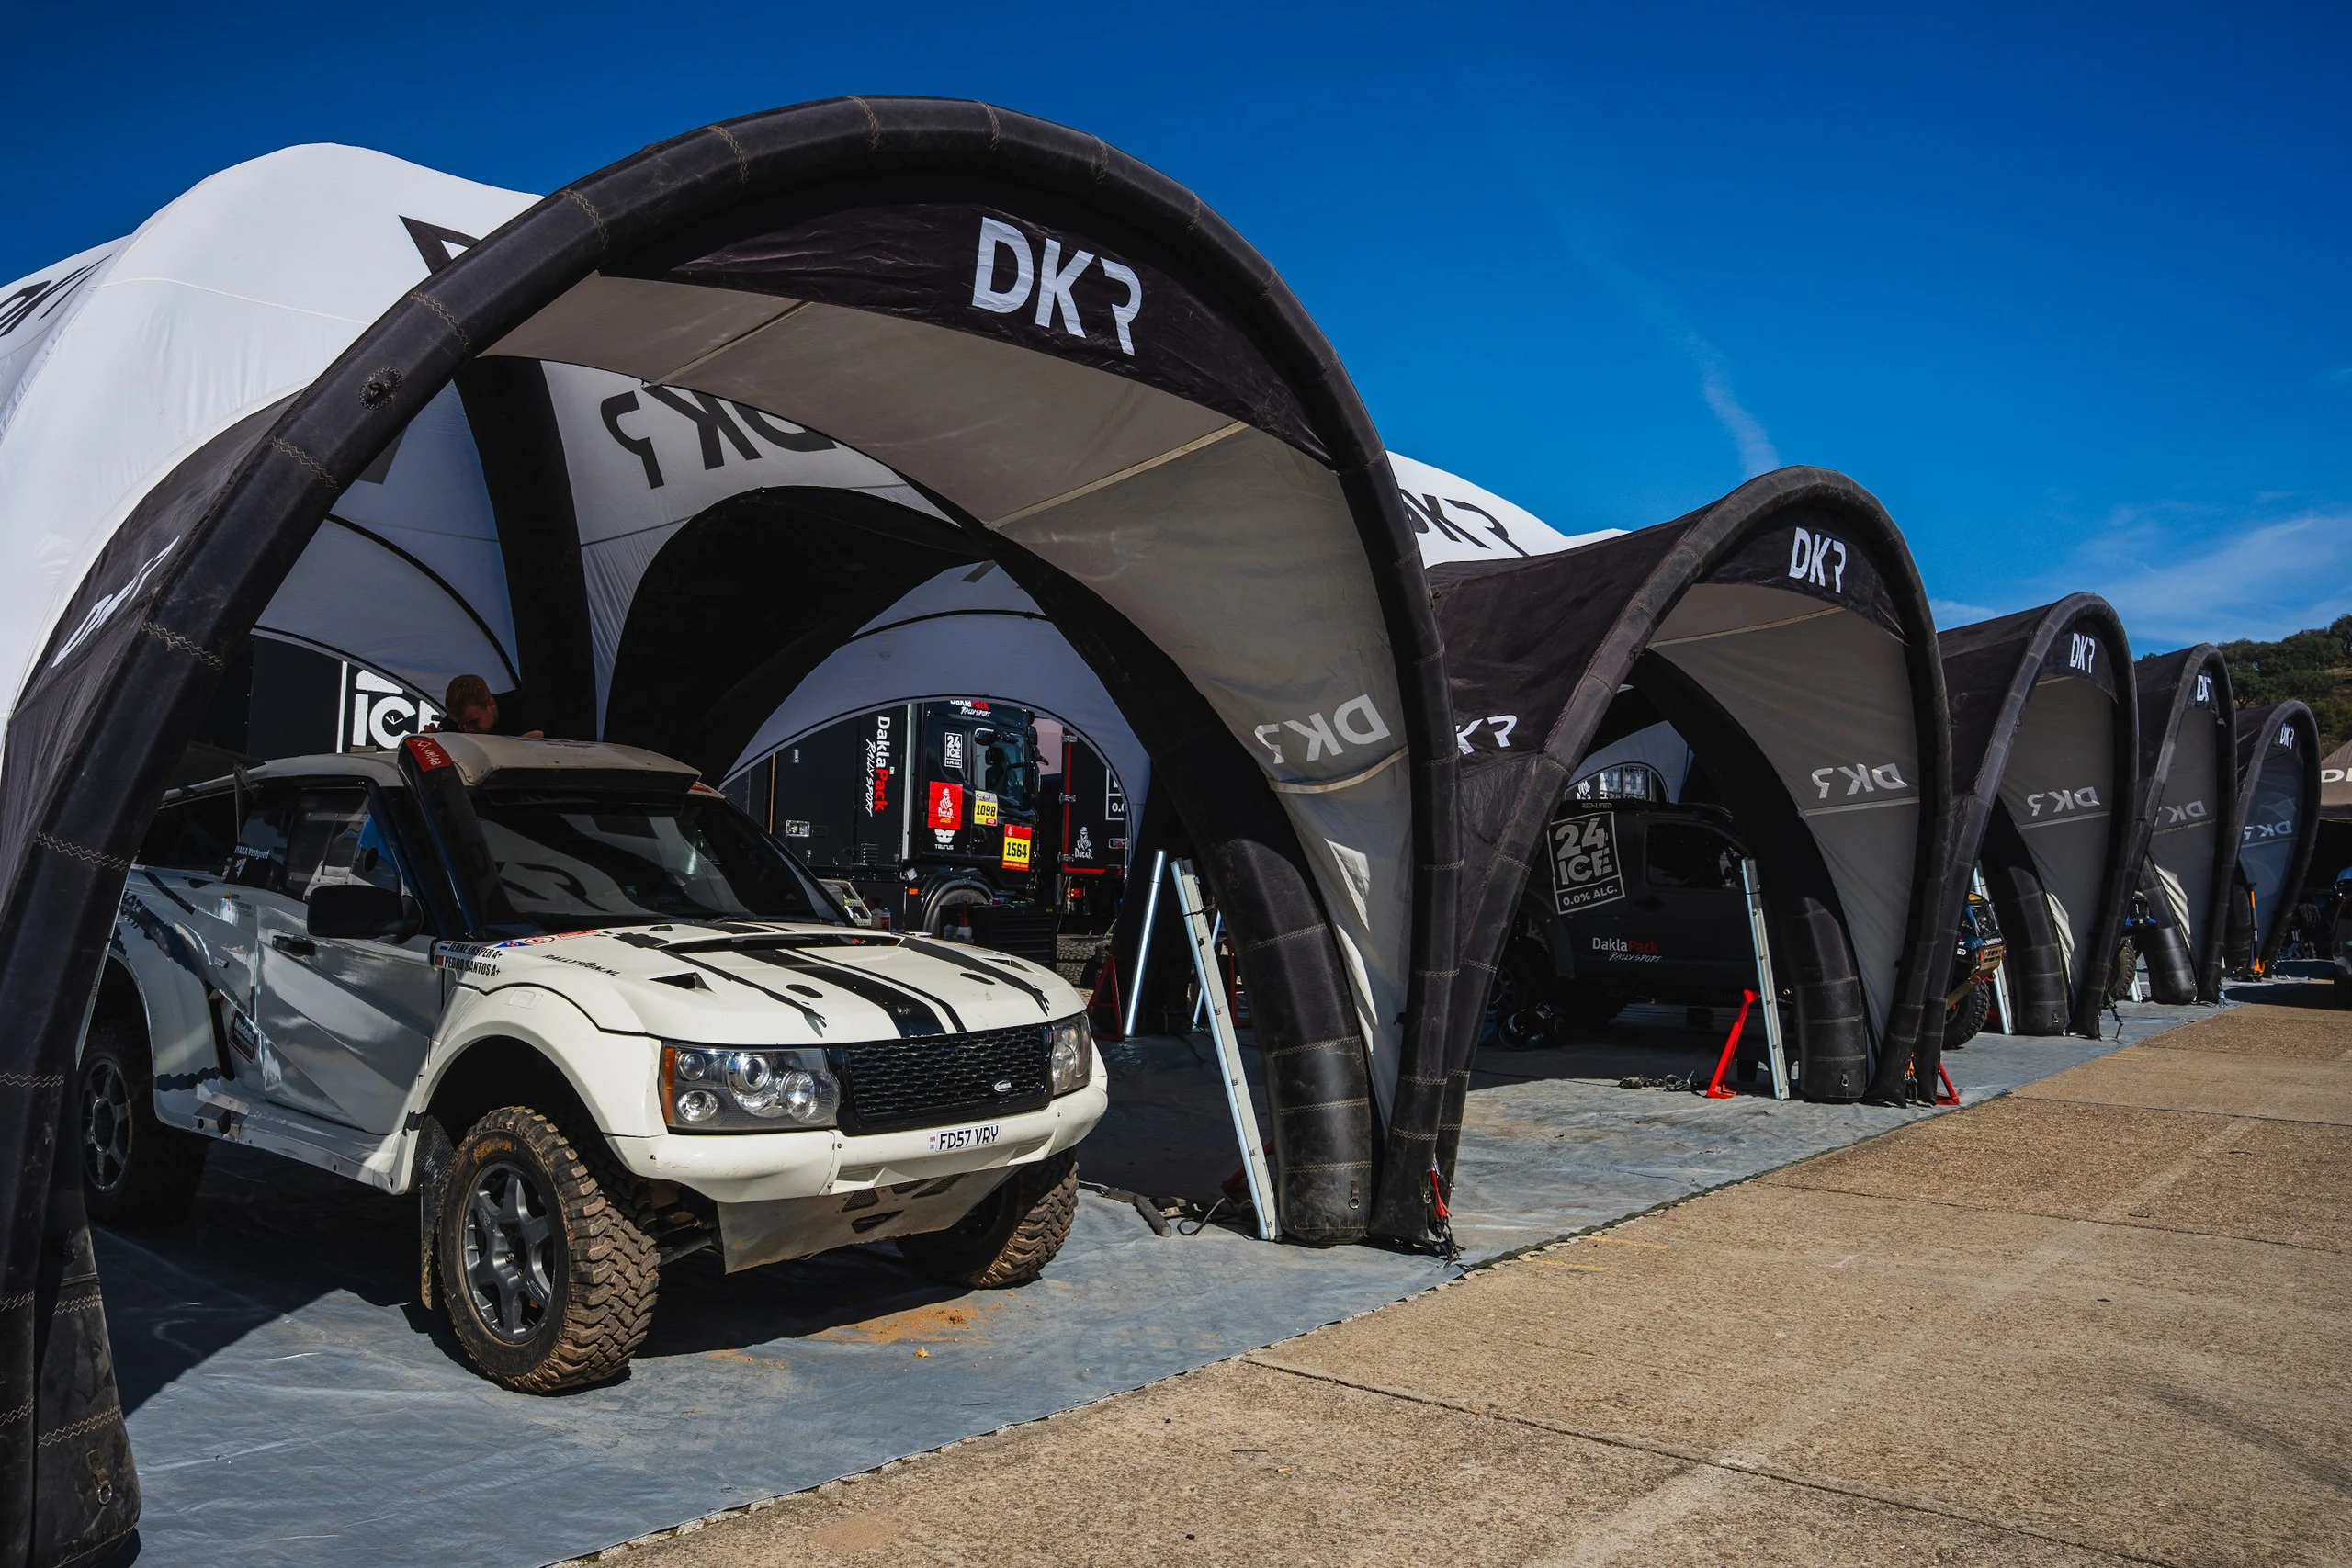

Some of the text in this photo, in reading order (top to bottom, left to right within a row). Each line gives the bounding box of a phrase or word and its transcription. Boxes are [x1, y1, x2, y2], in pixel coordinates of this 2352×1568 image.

[972, 217, 1142, 356] DKR
[1789, 526, 1847, 594] DKR
[2070, 633, 2095, 673] DKR
[947, 735, 961, 749] 24
[874, 716, 890, 812] DaklaPack
[946, 748, 961, 759] ICE
[976, 804, 996, 817] 1098
[1555, 817, 1609, 860] 24
[1006, 841, 1027, 858] 1564
[1558, 847, 1613, 885] ICE
[1563, 885, 1618, 906] 0.0% ALC.
[467, 945, 493, 958] JASPER
[1592, 937, 1658, 953] DaklaPack
[445, 956, 464, 970] PEDRO
[464, 960, 491, 976] SANTOS
[939, 1129, 971, 1150] FD57
[975, 1125, 999, 1145] VRY
